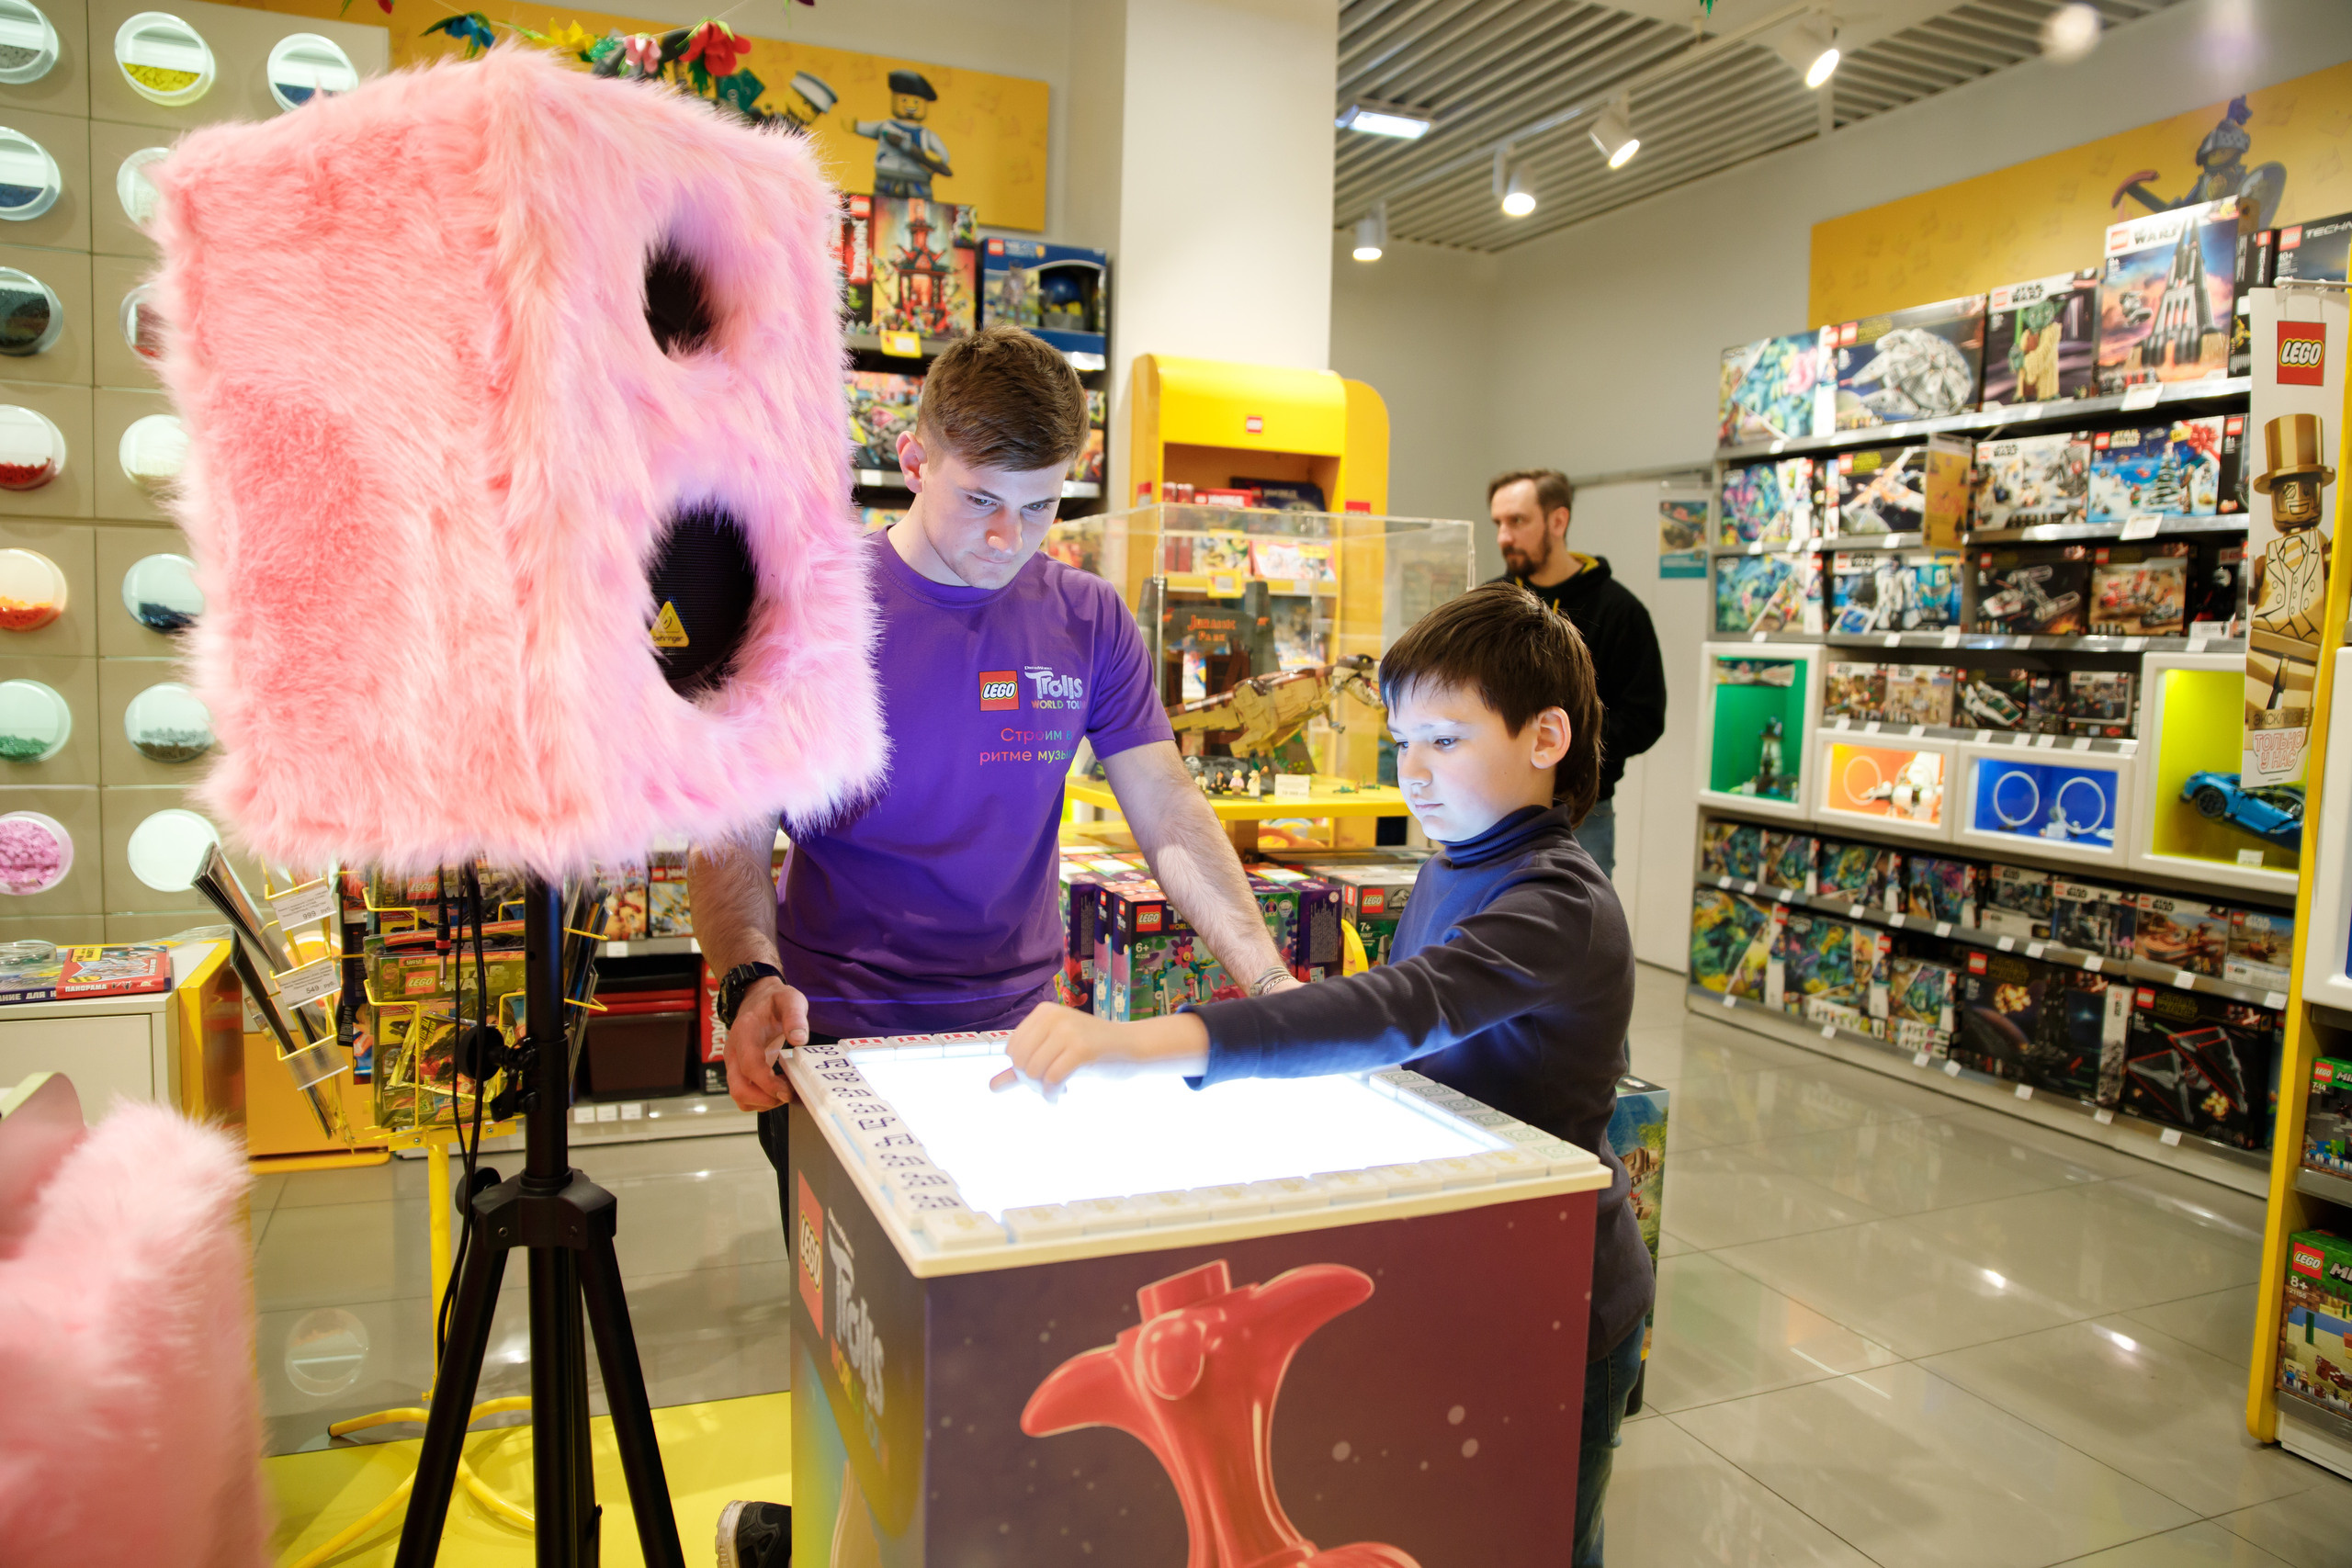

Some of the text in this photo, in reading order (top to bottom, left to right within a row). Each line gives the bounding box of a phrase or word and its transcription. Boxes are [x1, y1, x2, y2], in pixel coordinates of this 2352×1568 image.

[2279, 338, 2324, 367] LEGO
[981, 681, 1017, 700] LEGO
[1024, 670, 1083, 700] Trolls
[1031, 699, 1064, 709] WORLD
[1001, 728, 1072, 745] Строим в
[2255, 731, 2304, 752] ТОЛЬКО
[979, 750, 1075, 766] ритме музык
[2261, 749, 2296, 770] У НАС
[410, 881, 436, 894] LEGO
[1363, 896, 1384, 906] LEGO
[302, 910, 317, 919] 999
[1138, 912, 1161, 924] LEGO
[1360, 922, 1371, 931] 7+
[1135, 942, 1149, 953] 6+
[65, 984, 107, 992] ПАНОРАМА
[407, 977, 435, 987] LEGO
[26, 991, 46, 999] ДЛЯ
[306, 985, 320, 994] 549
[800, 1213, 821, 1292] LEGO
[2294, 1252, 2323, 1270] LEGO
[2290, 1275, 2308, 1290] 8+
